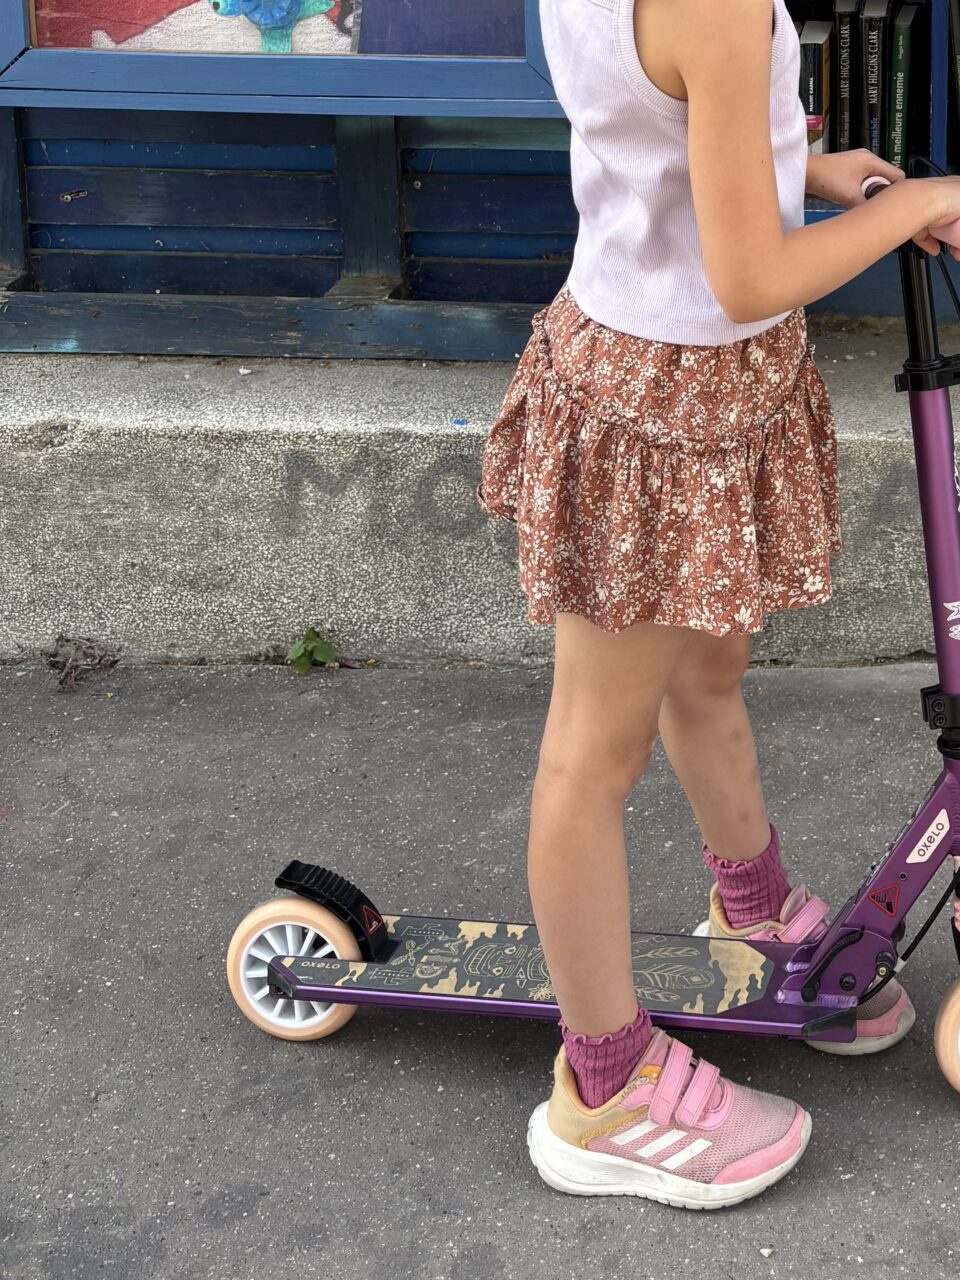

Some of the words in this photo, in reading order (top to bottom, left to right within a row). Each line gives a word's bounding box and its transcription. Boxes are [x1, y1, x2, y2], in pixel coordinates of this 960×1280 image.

[841, 24, 850, 47] CLARK
[869, 29, 879, 54] CLARK
[841, 48, 850, 79] HIGGINS
[868, 55, 879, 85] HIGGINS
[841, 81, 850, 98] MARY
[868, 86, 878, 104] MARY
[893, 72, 905, 110] ennemie
[891, 111, 902, 153] meilleure
